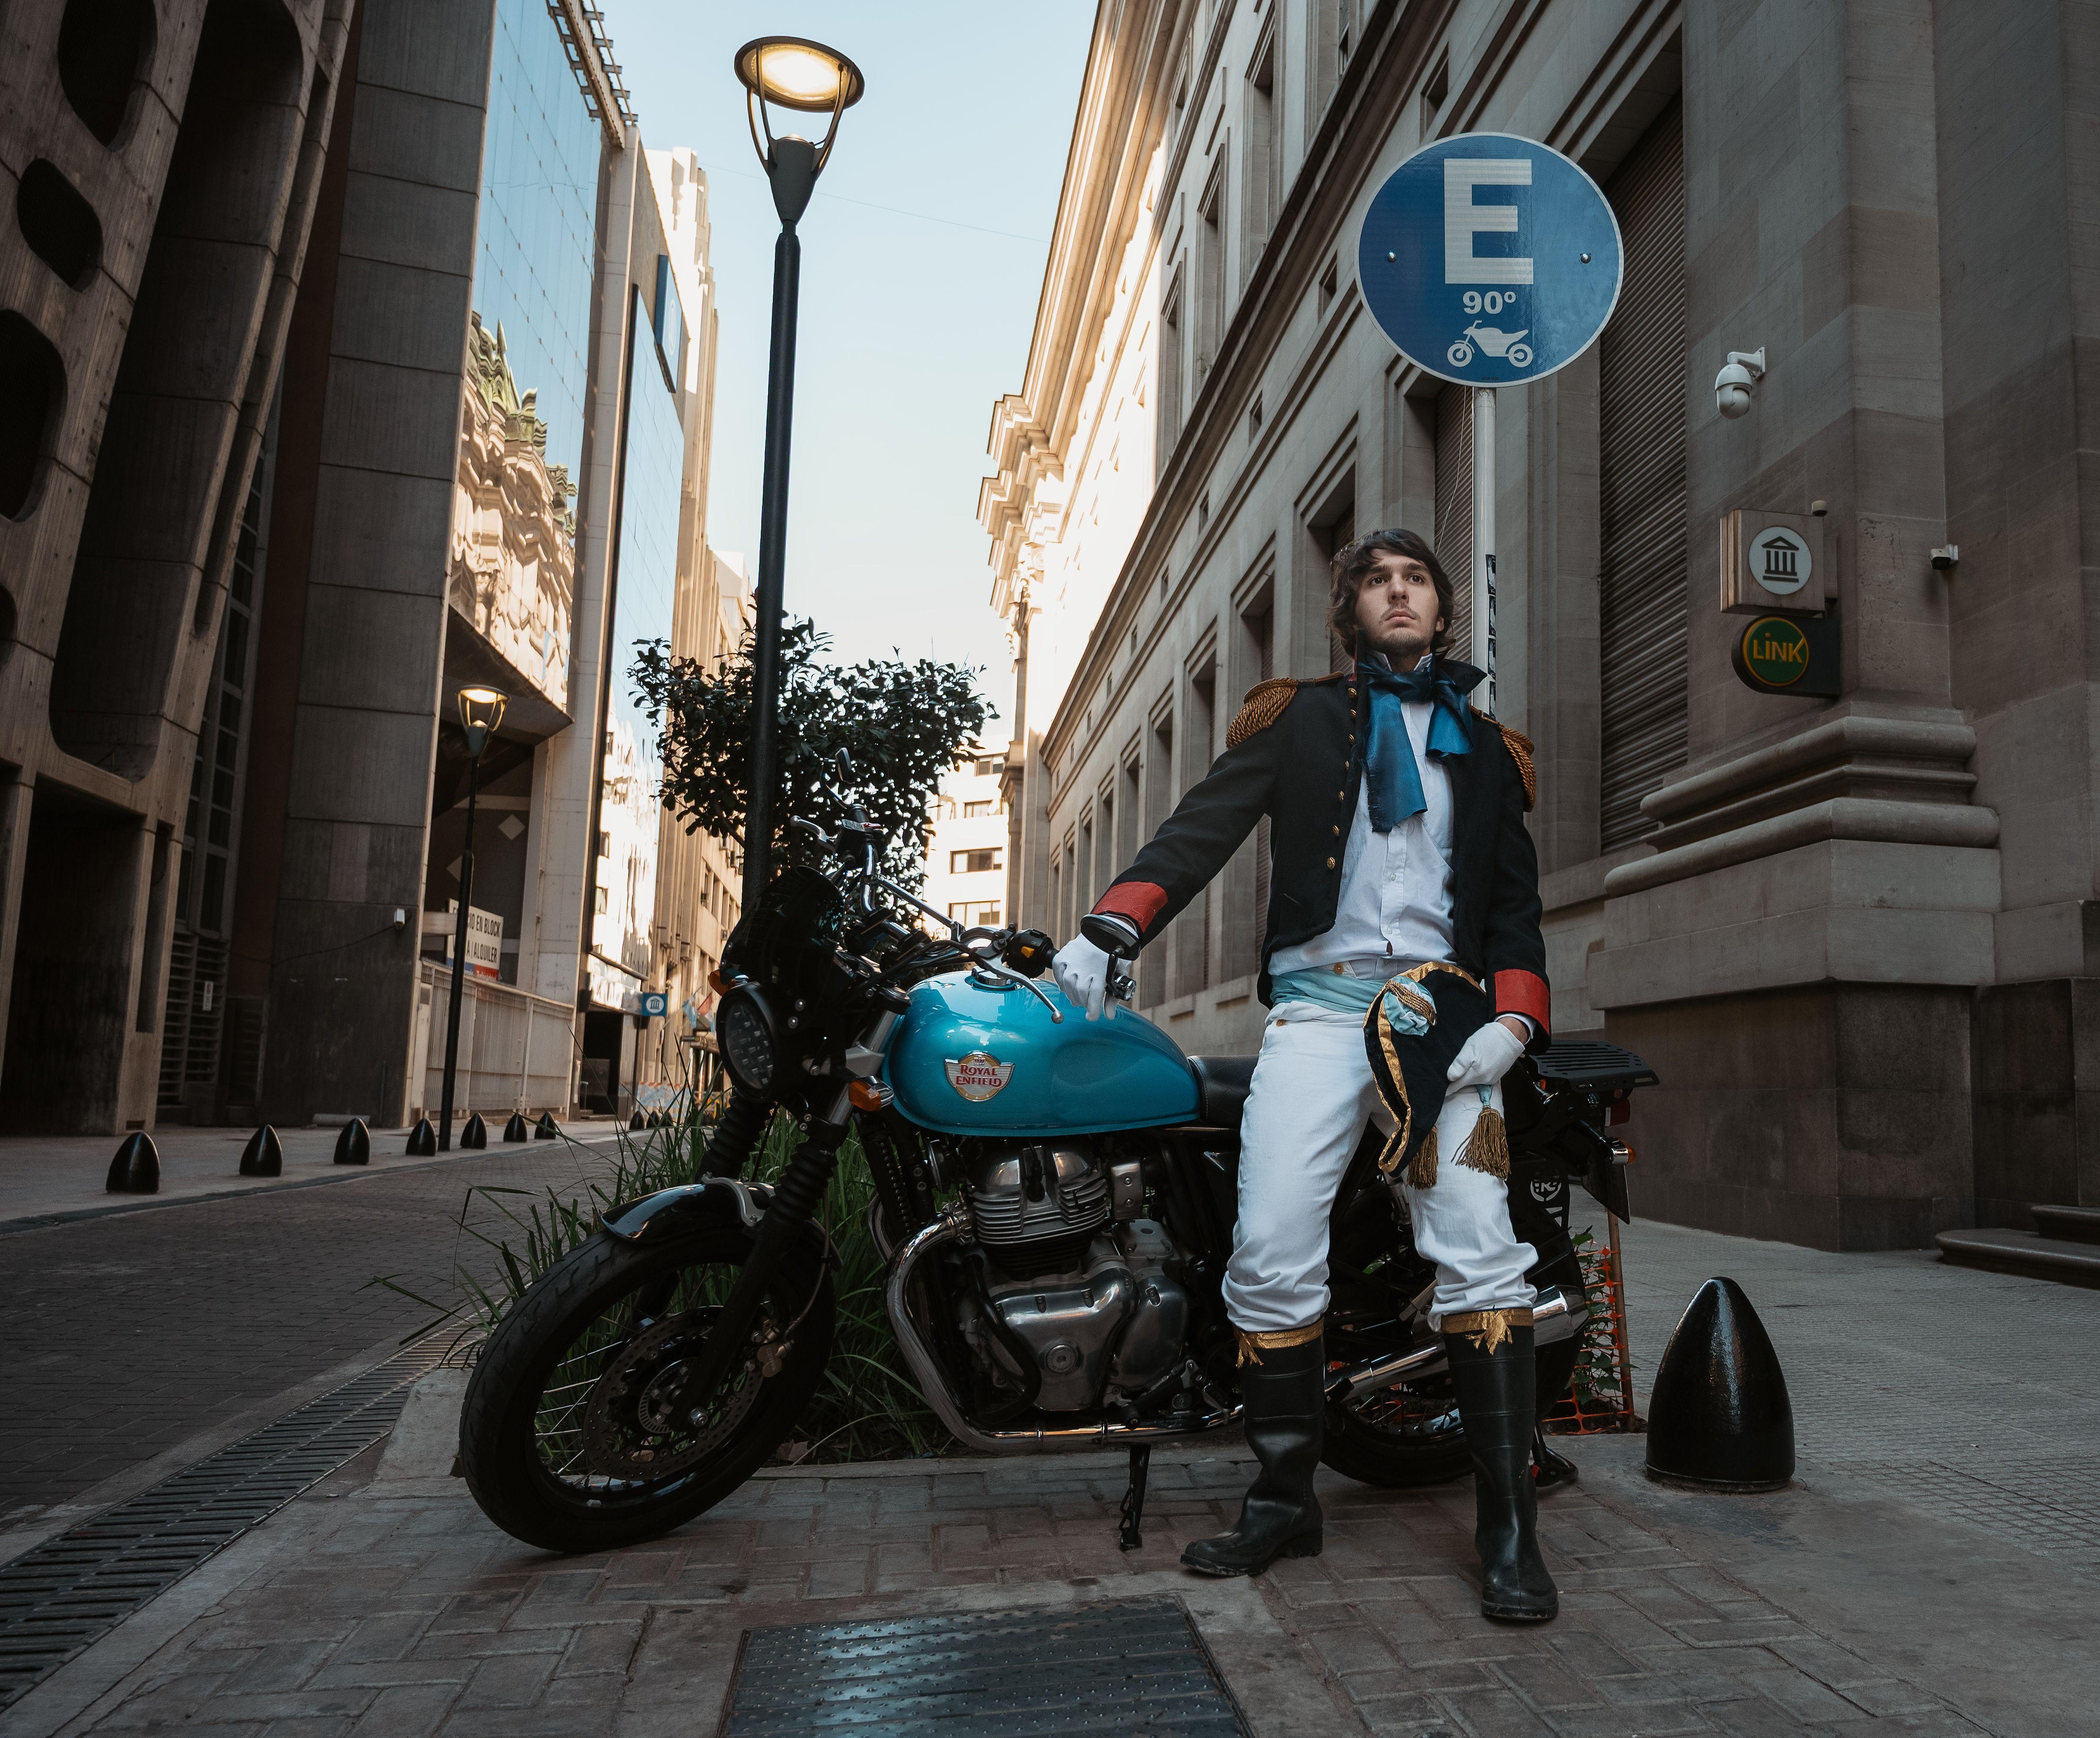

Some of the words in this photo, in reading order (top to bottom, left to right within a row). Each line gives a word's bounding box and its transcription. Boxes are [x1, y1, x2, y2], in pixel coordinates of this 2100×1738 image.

[1444, 159, 1534, 284] E
[476, 915, 483, 932] EN
[484, 919, 500, 937] BLOCK
[473, 942, 497, 963] ALQUILER
[960, 1064, 998, 1076] ROYAL
[955, 1075, 1002, 1087] ENFIELD
